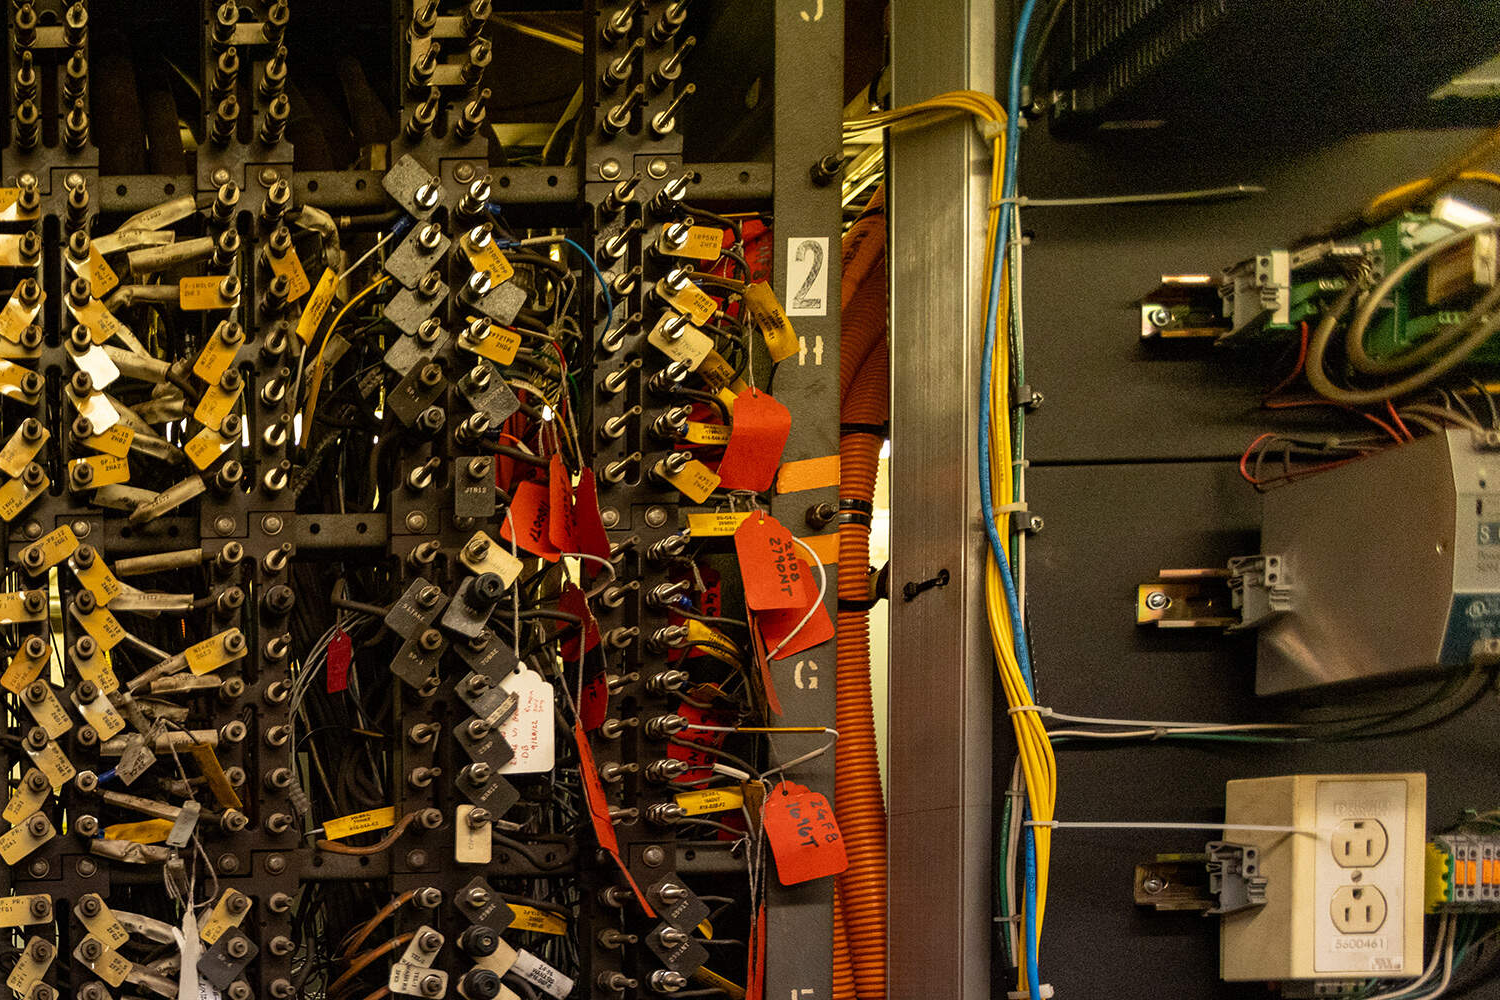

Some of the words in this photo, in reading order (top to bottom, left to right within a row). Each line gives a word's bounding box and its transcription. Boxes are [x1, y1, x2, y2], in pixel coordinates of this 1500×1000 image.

[793, 239, 827, 311] 2
[798, 336, 824, 366] H
[770, 538, 793, 597] 2790NT
[785, 541, 800, 582] 2HD8
[794, 661, 818, 690] G
[811, 801, 838, 843] 2GF8
